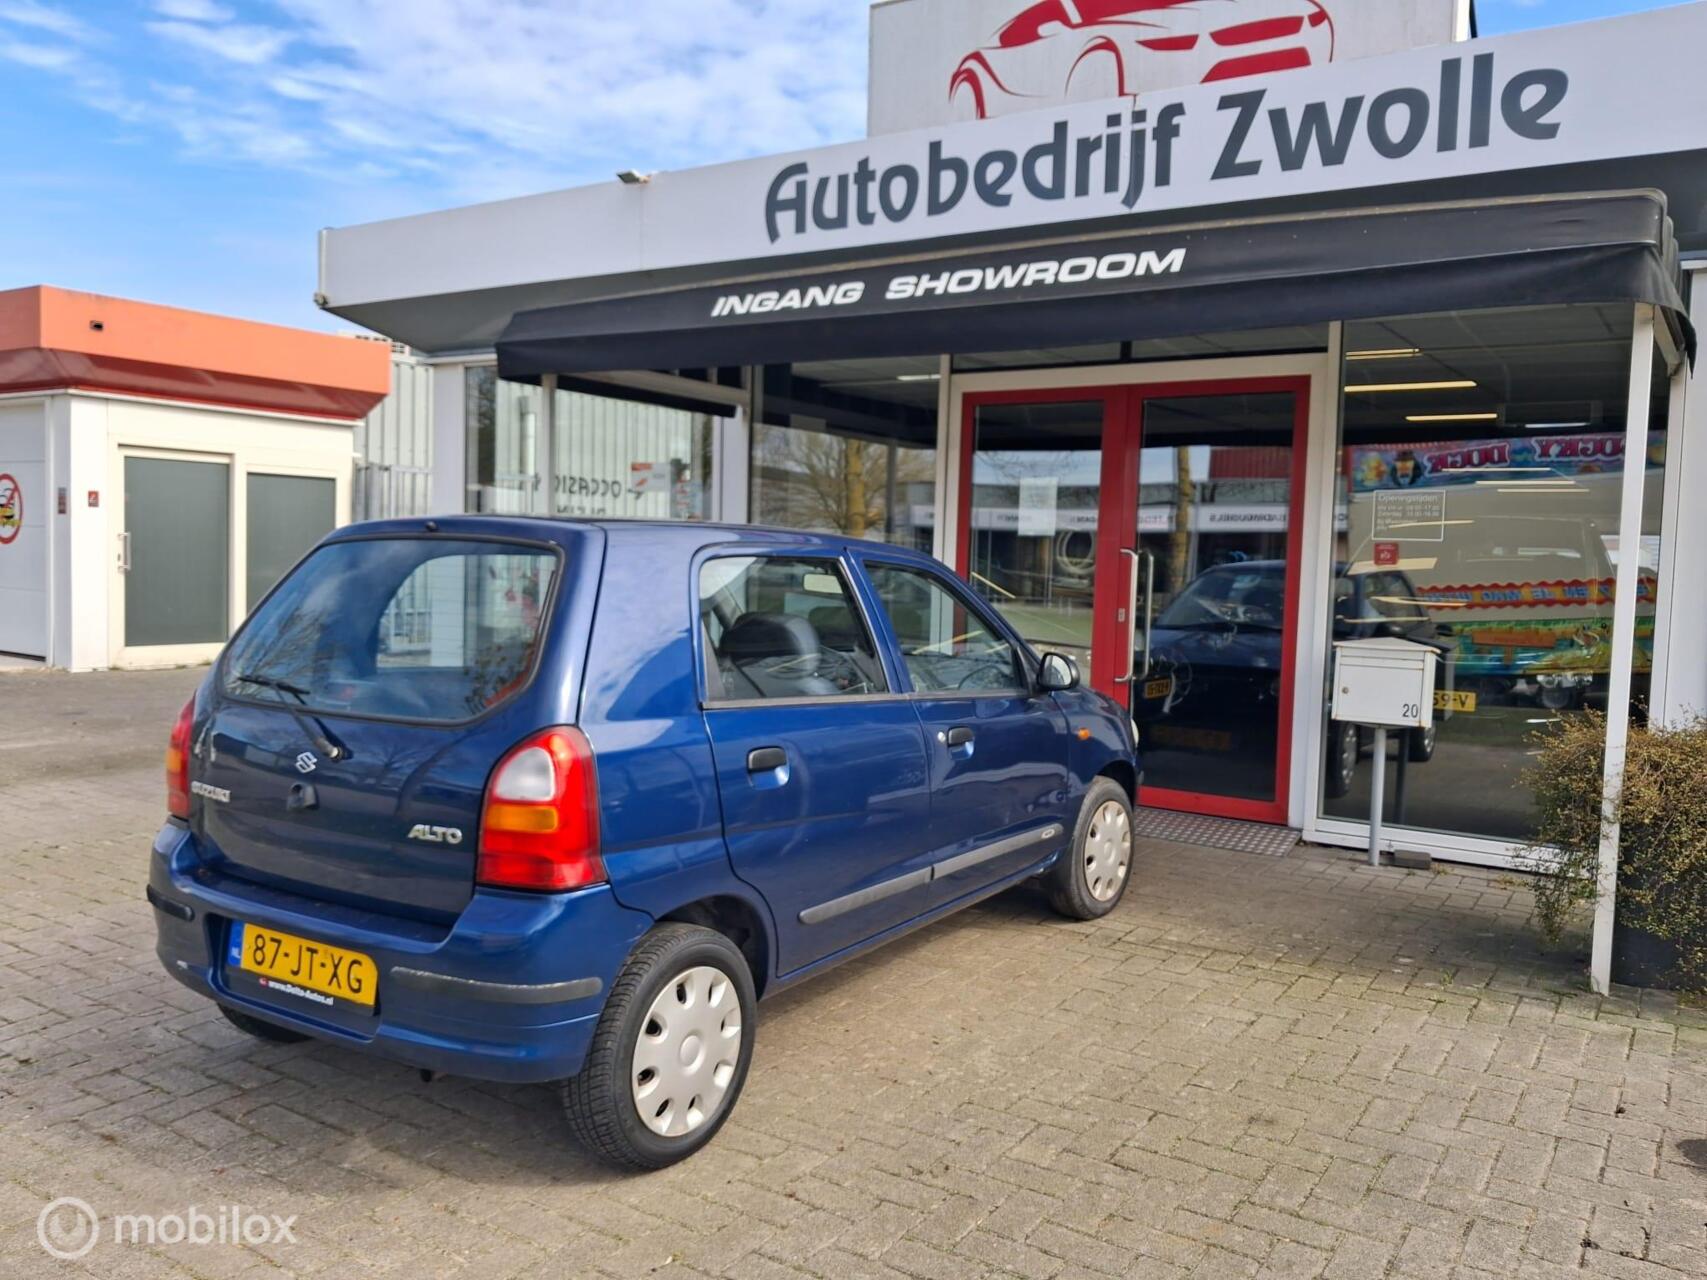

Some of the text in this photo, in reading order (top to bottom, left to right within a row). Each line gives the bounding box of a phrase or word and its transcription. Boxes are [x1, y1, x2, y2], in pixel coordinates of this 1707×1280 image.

[765, 51, 1569, 244] Autobedrijf Zwolle
[711, 247, 1186, 317] INGANG SHOWROOM
[1402, 703, 1419, 718] 20
[407, 823, 463, 844] ALTO
[252, 933, 363, 994] 87-JT-XG
